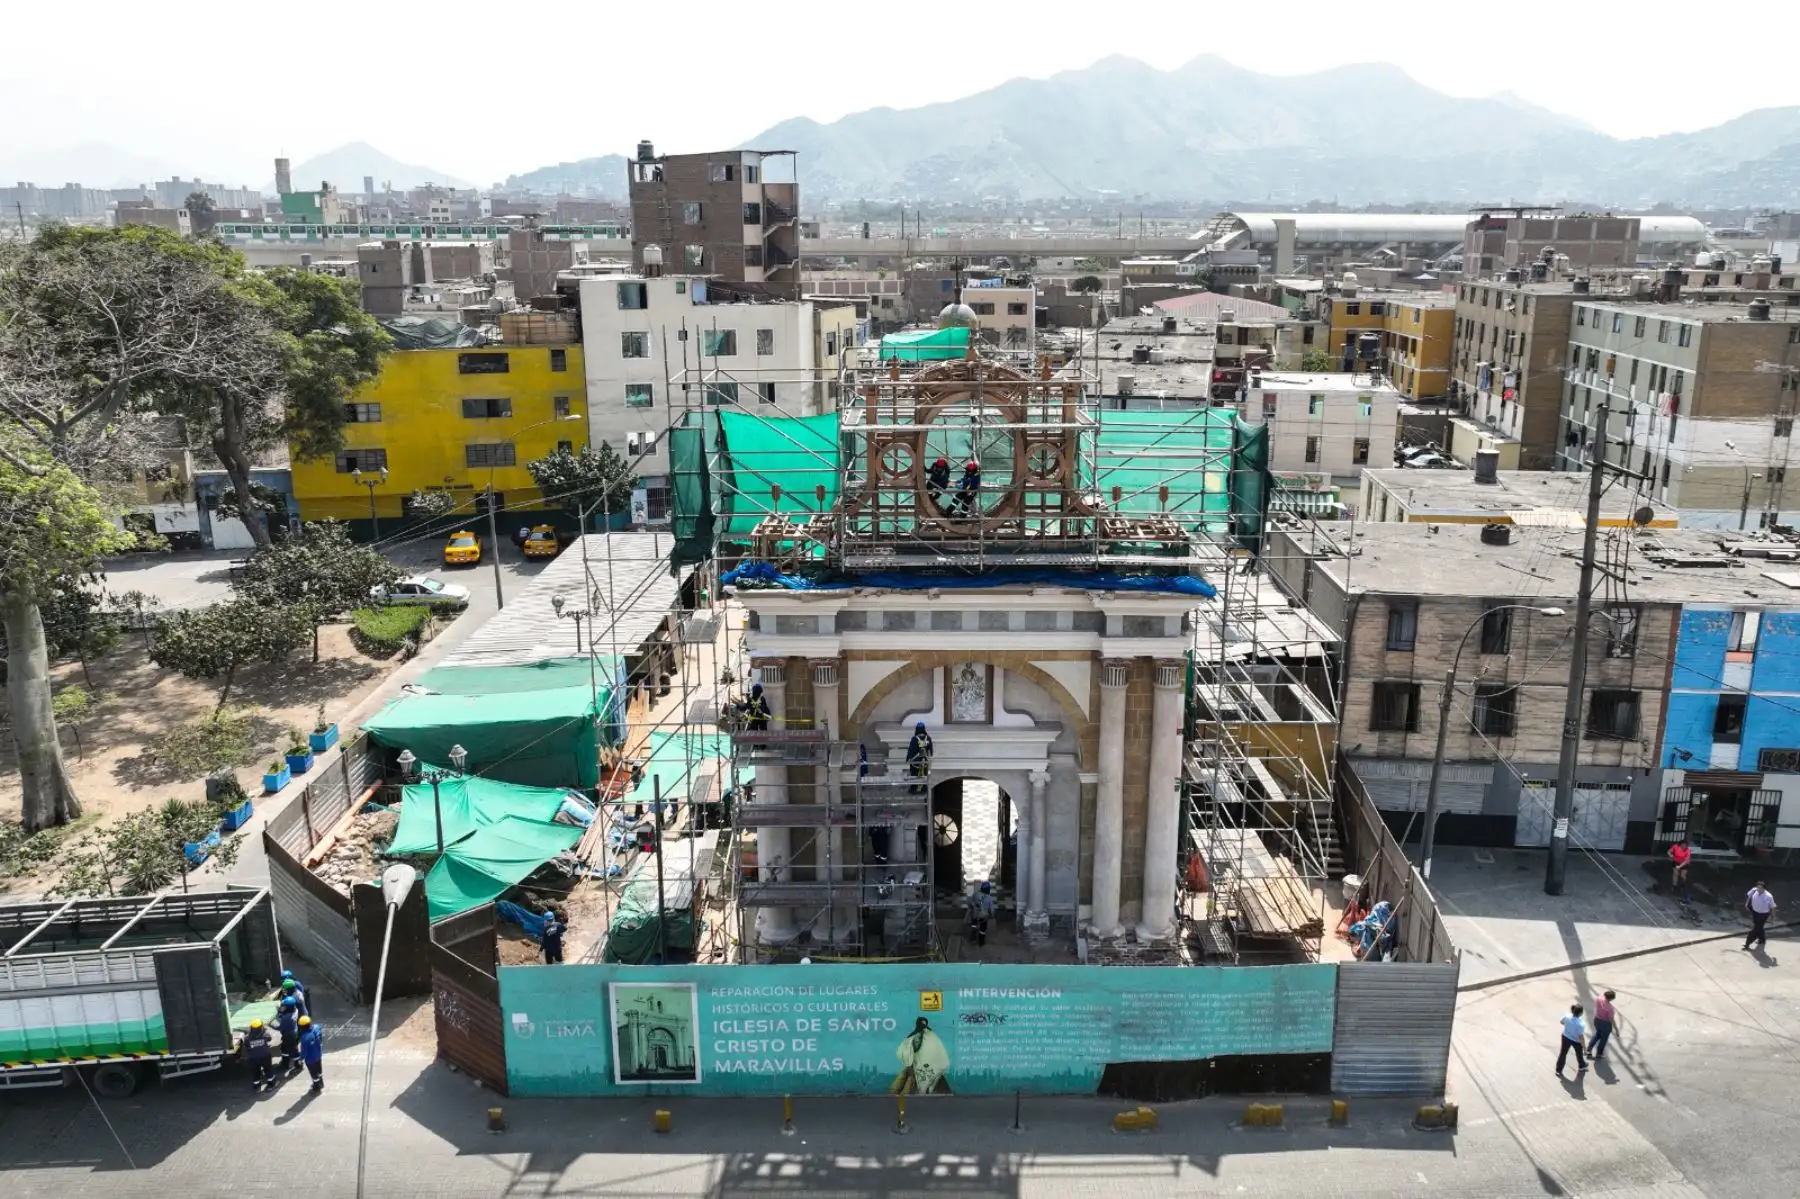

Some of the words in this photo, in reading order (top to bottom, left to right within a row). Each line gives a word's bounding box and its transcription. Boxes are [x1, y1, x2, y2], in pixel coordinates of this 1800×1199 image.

[799, 986, 815, 996] DE
[819, 985, 878, 996] LUGARES
[959, 987, 1062, 998] INTERVENCIÓN
[712, 1002, 790, 1014] HISTÓRICOS
[793, 1002, 804, 1012] O
[808, 1001, 889, 1012] CULTURALES
[713, 1019, 789, 1034] IGLESIA
[796, 1018, 821, 1032] DE
[828, 1018, 897, 1032] SANTO
[714, 1039, 785, 1053] CRISTO
[792, 1038, 818, 1052] DE
[715, 1058, 845, 1073] MARAVILLAS
